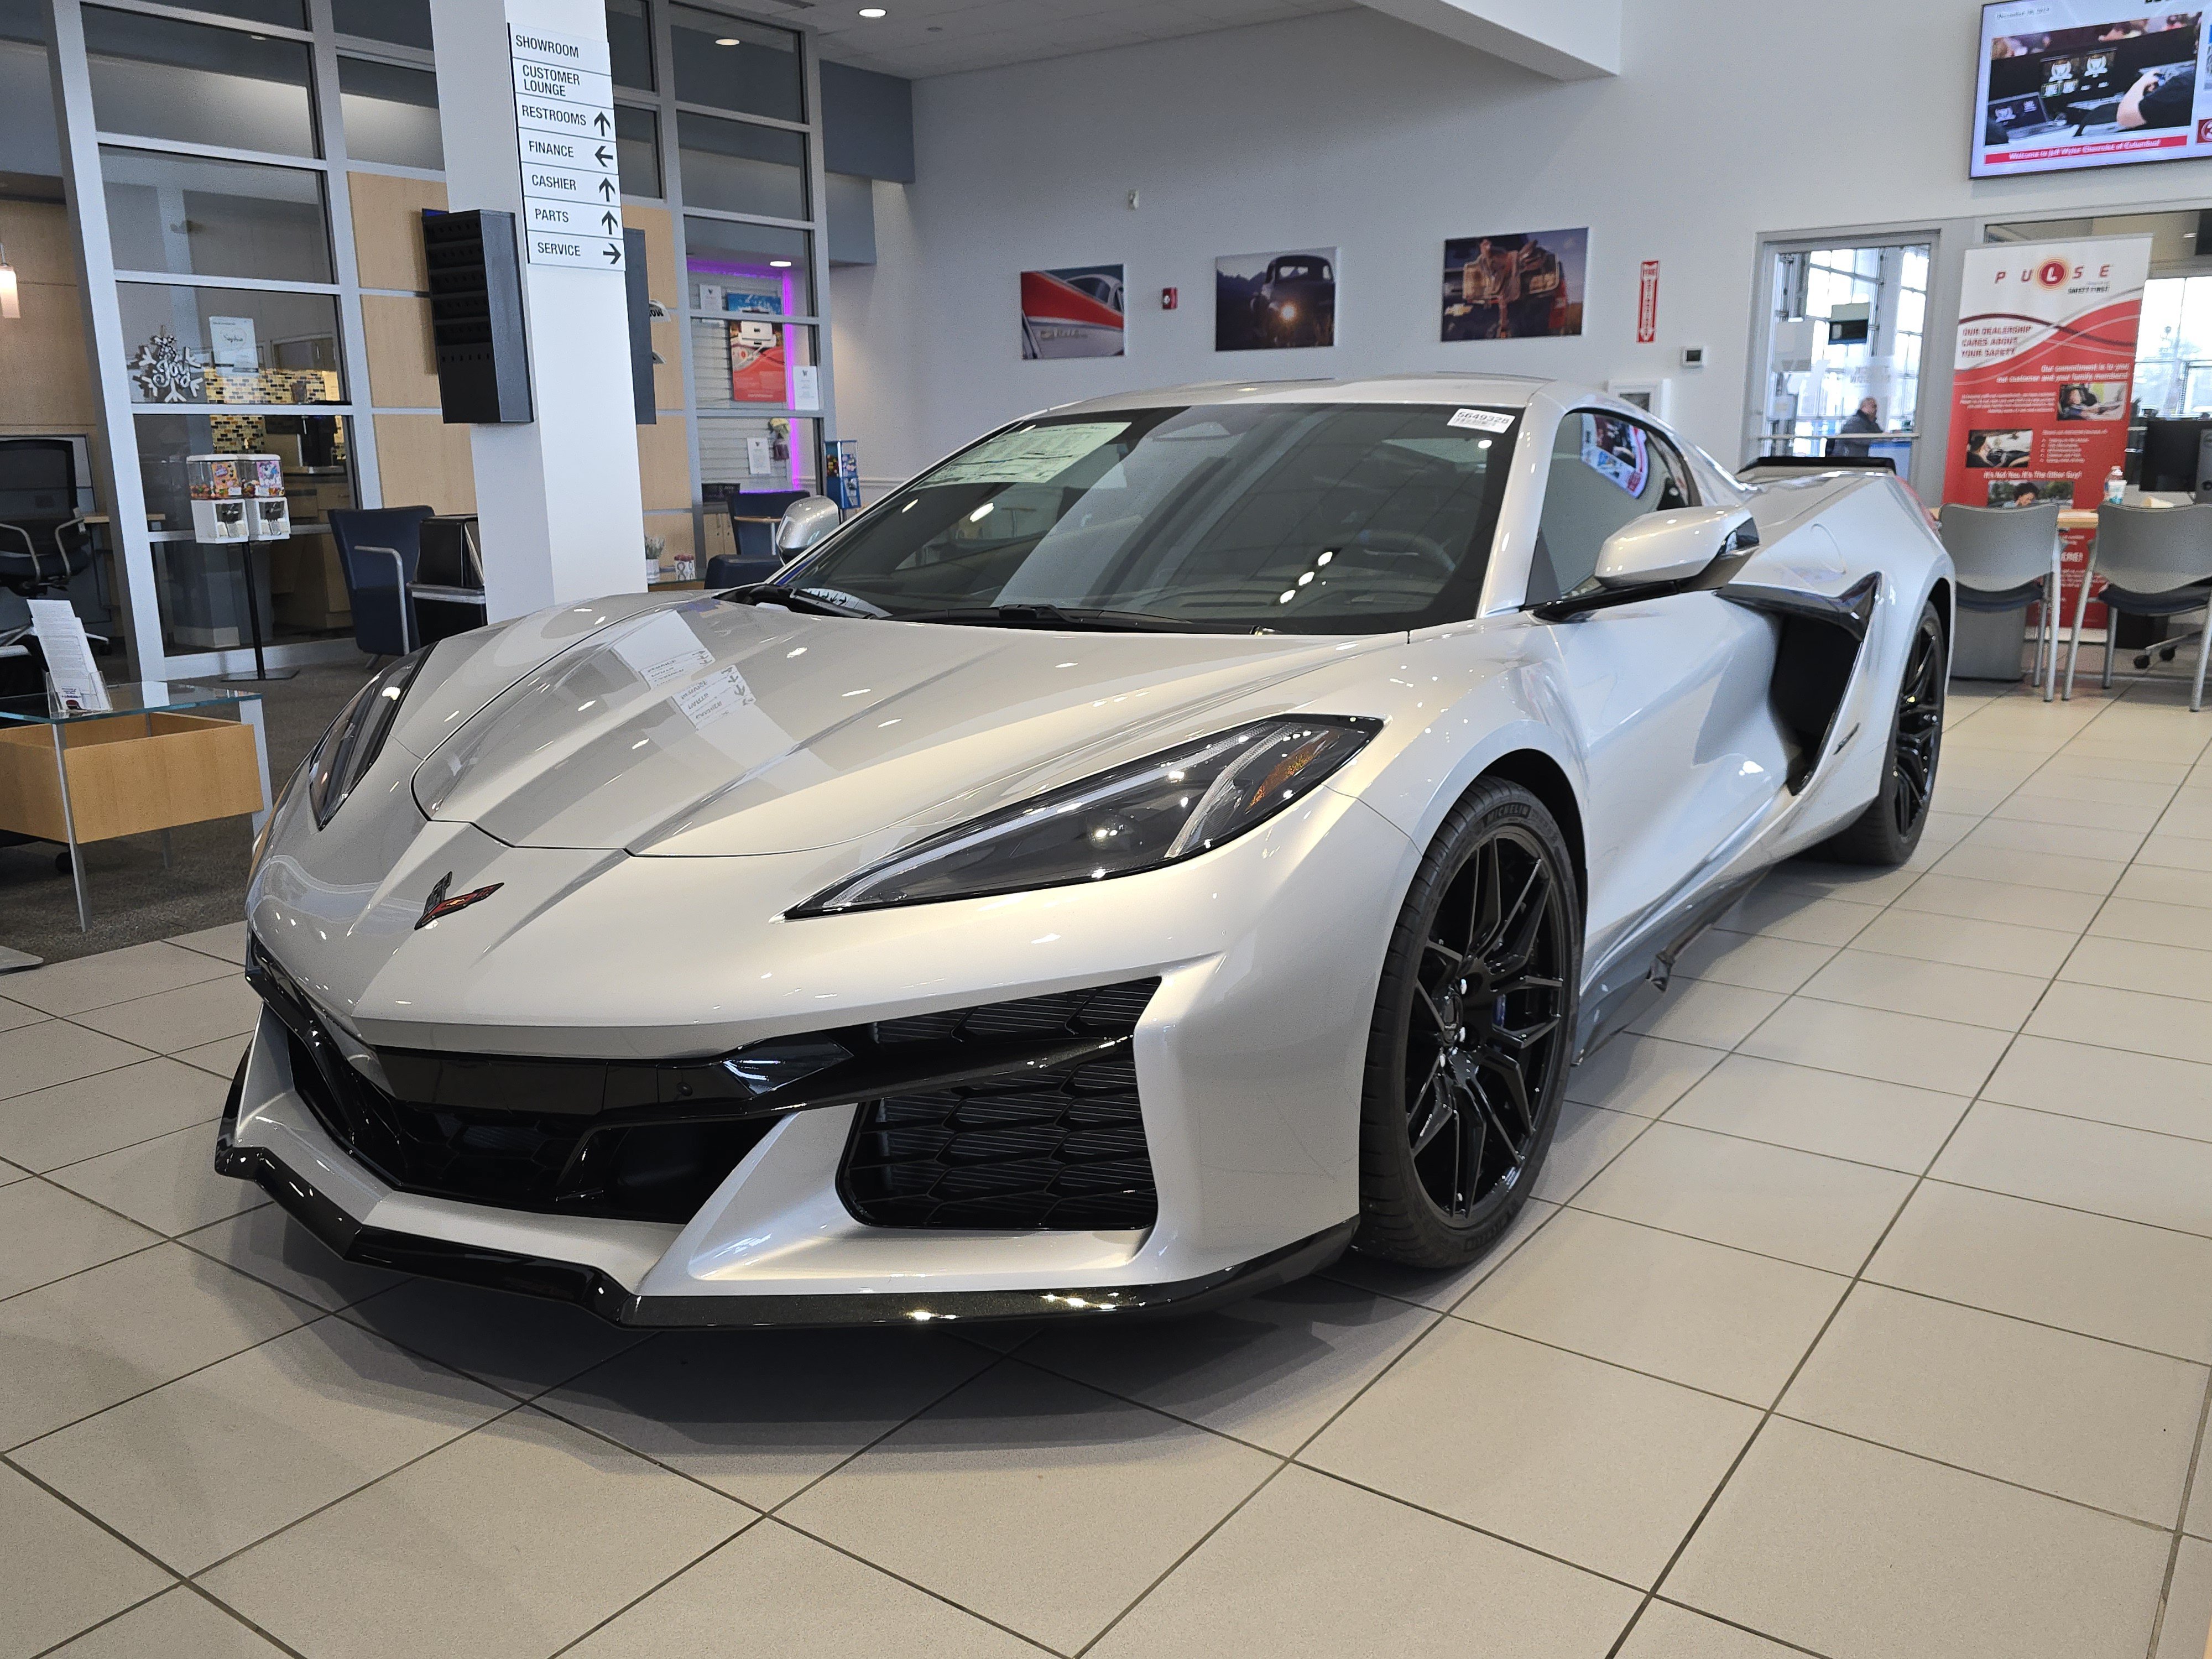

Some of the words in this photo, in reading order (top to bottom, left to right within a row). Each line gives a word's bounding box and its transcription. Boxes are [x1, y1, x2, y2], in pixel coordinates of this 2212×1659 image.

[515, 34, 579, 58] SHOWROOM
[523, 65, 580, 86] CUSTOMER
[524, 79, 566, 97] LOUNGE
[521, 105, 586, 126] RESTROOMS
[529, 140, 574, 157] FINANCE
[532, 174, 576, 191] CASHIER
[535, 208, 569, 222] PARTS
[538, 242, 581, 257] SERVICE
[1994, 265, 2110, 284] PULSE
[1982, 325, 2032, 335] DEALERSHIP
[1961, 337, 1988, 347] CARES
[1991, 336, 2018, 346] ABOUT
[1985, 347, 2016, 357] SAFETY
[2055, 364, 2097, 372] commitment
